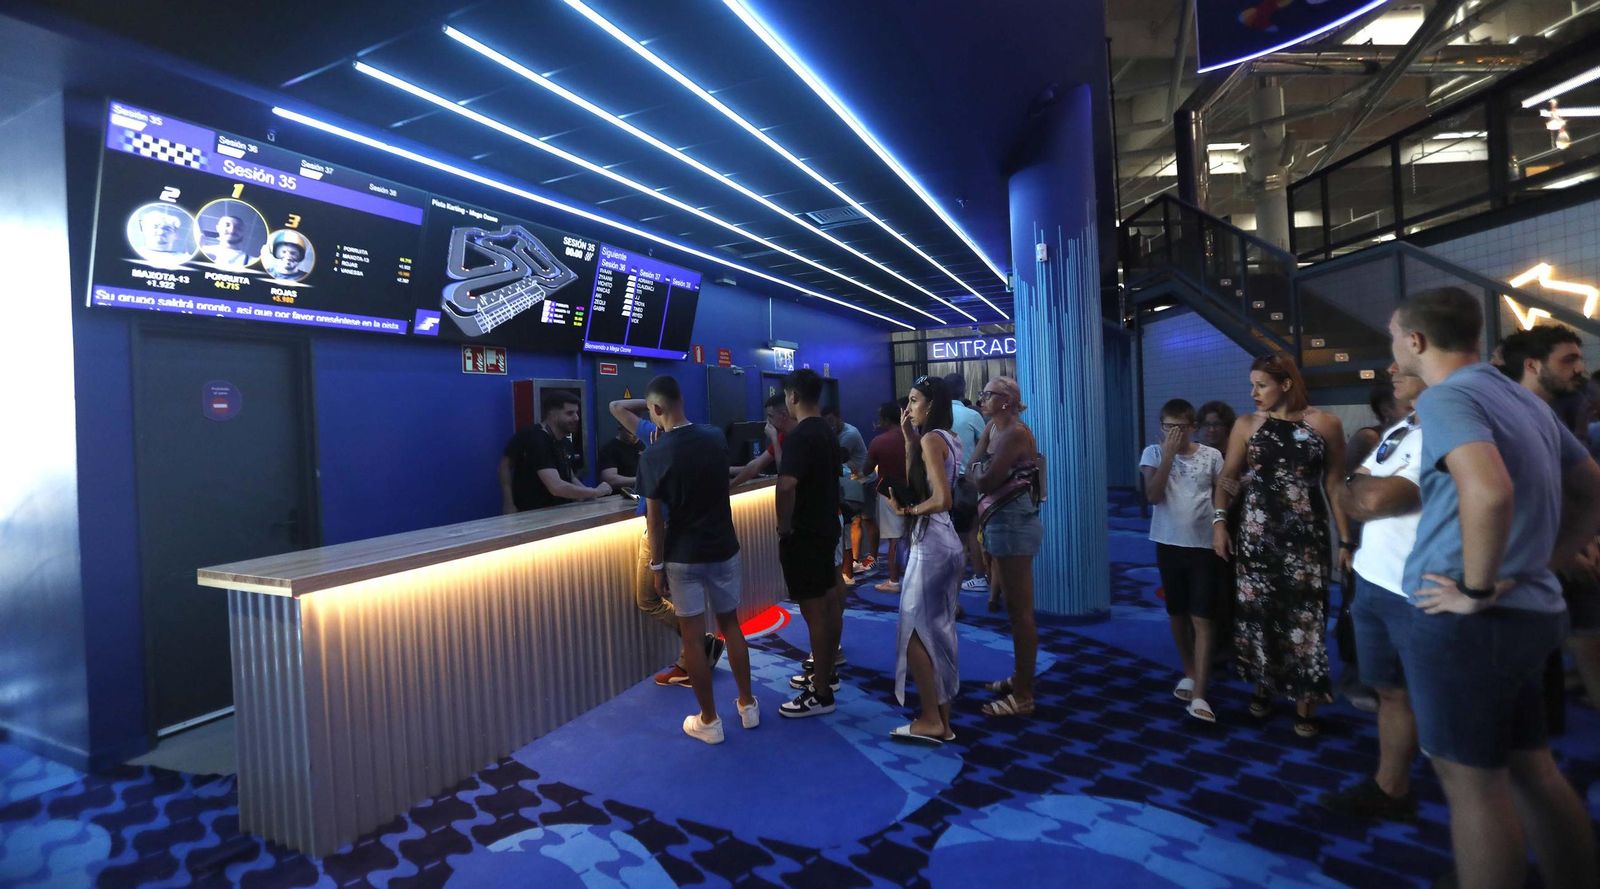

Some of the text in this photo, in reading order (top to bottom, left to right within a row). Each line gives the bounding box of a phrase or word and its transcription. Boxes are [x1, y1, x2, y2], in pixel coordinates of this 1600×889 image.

[111, 104, 149, 122] Sesión
[218, 135, 247, 151] Sesión
[222, 159, 297, 191] Sesión 35
[300, 159, 334, 175] Sesión 37
[159, 186, 181, 203] 2
[231, 183, 245, 198] 1
[368, 182, 389, 196] Sesión
[284, 213, 301, 229] 3
[563, 236, 596, 252] SESIÓN 35
[601, 246, 627, 262] Siguiente
[601, 258, 619, 270] Sesión
[131, 268, 190, 284] MAXOTA-13
[204, 271, 250, 285] PORRUITA
[639, 268, 655, 279] Sesión
[672, 277, 686, 288] Sesión
[270, 287, 298, 298] ROJAS
[95, 289, 115, 301] Su
[157, 297, 194, 309] saldrá
[236, 306, 252, 316] así
[292, 311, 316, 322] favor
[361, 320, 373, 328] en
[932, 337, 1017, 359] ENTRAD
